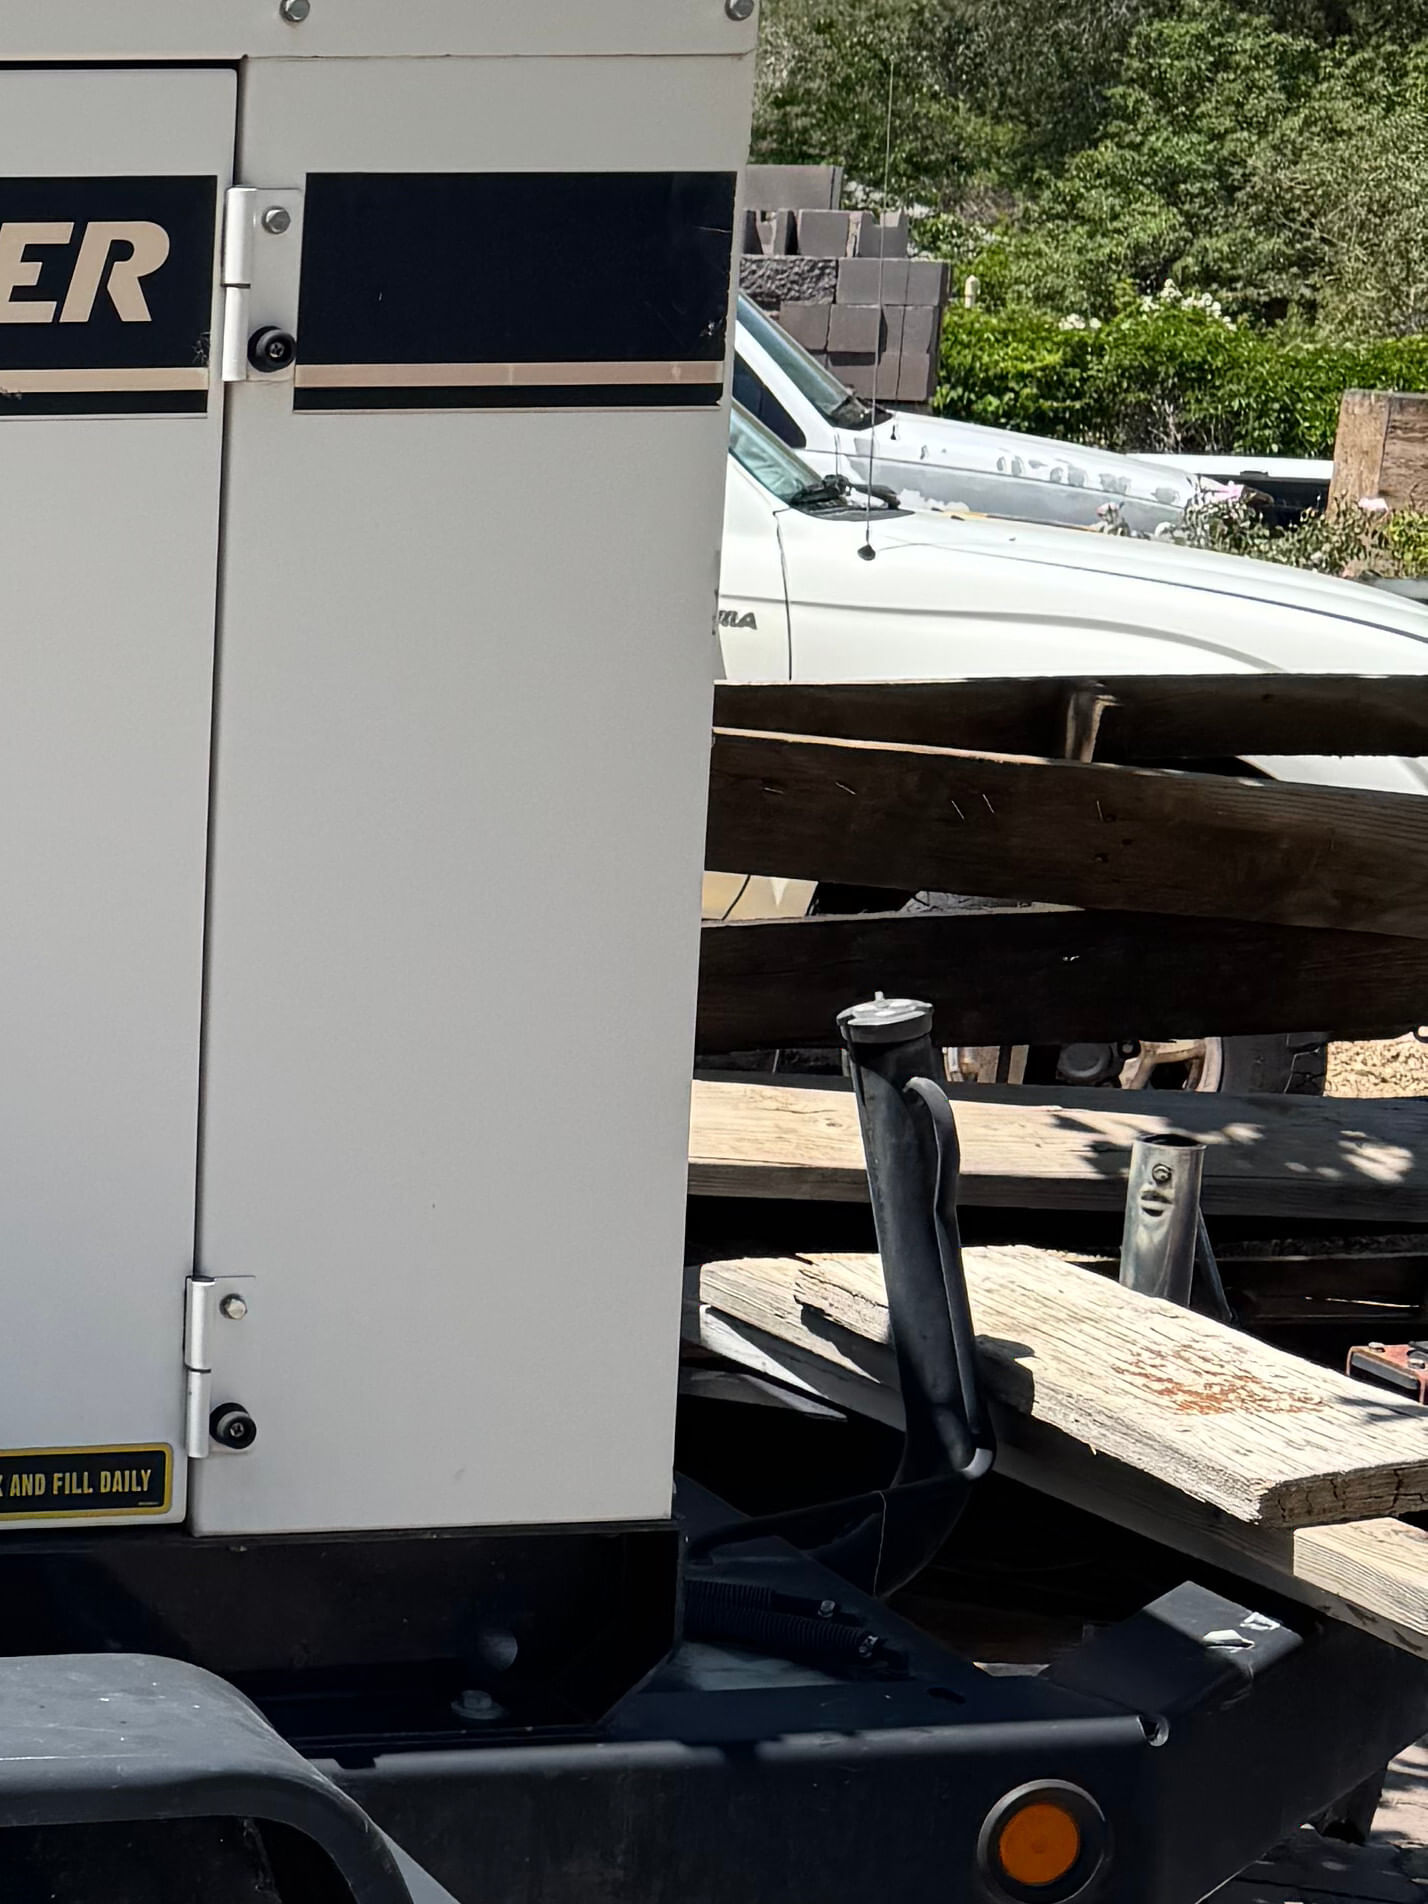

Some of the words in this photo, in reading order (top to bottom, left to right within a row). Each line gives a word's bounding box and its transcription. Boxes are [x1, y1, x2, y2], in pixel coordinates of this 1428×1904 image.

[9, 1472, 45, 1497] AND
[52, 1471, 93, 1496] FILL
[99, 1468, 152, 1493] DAILY
